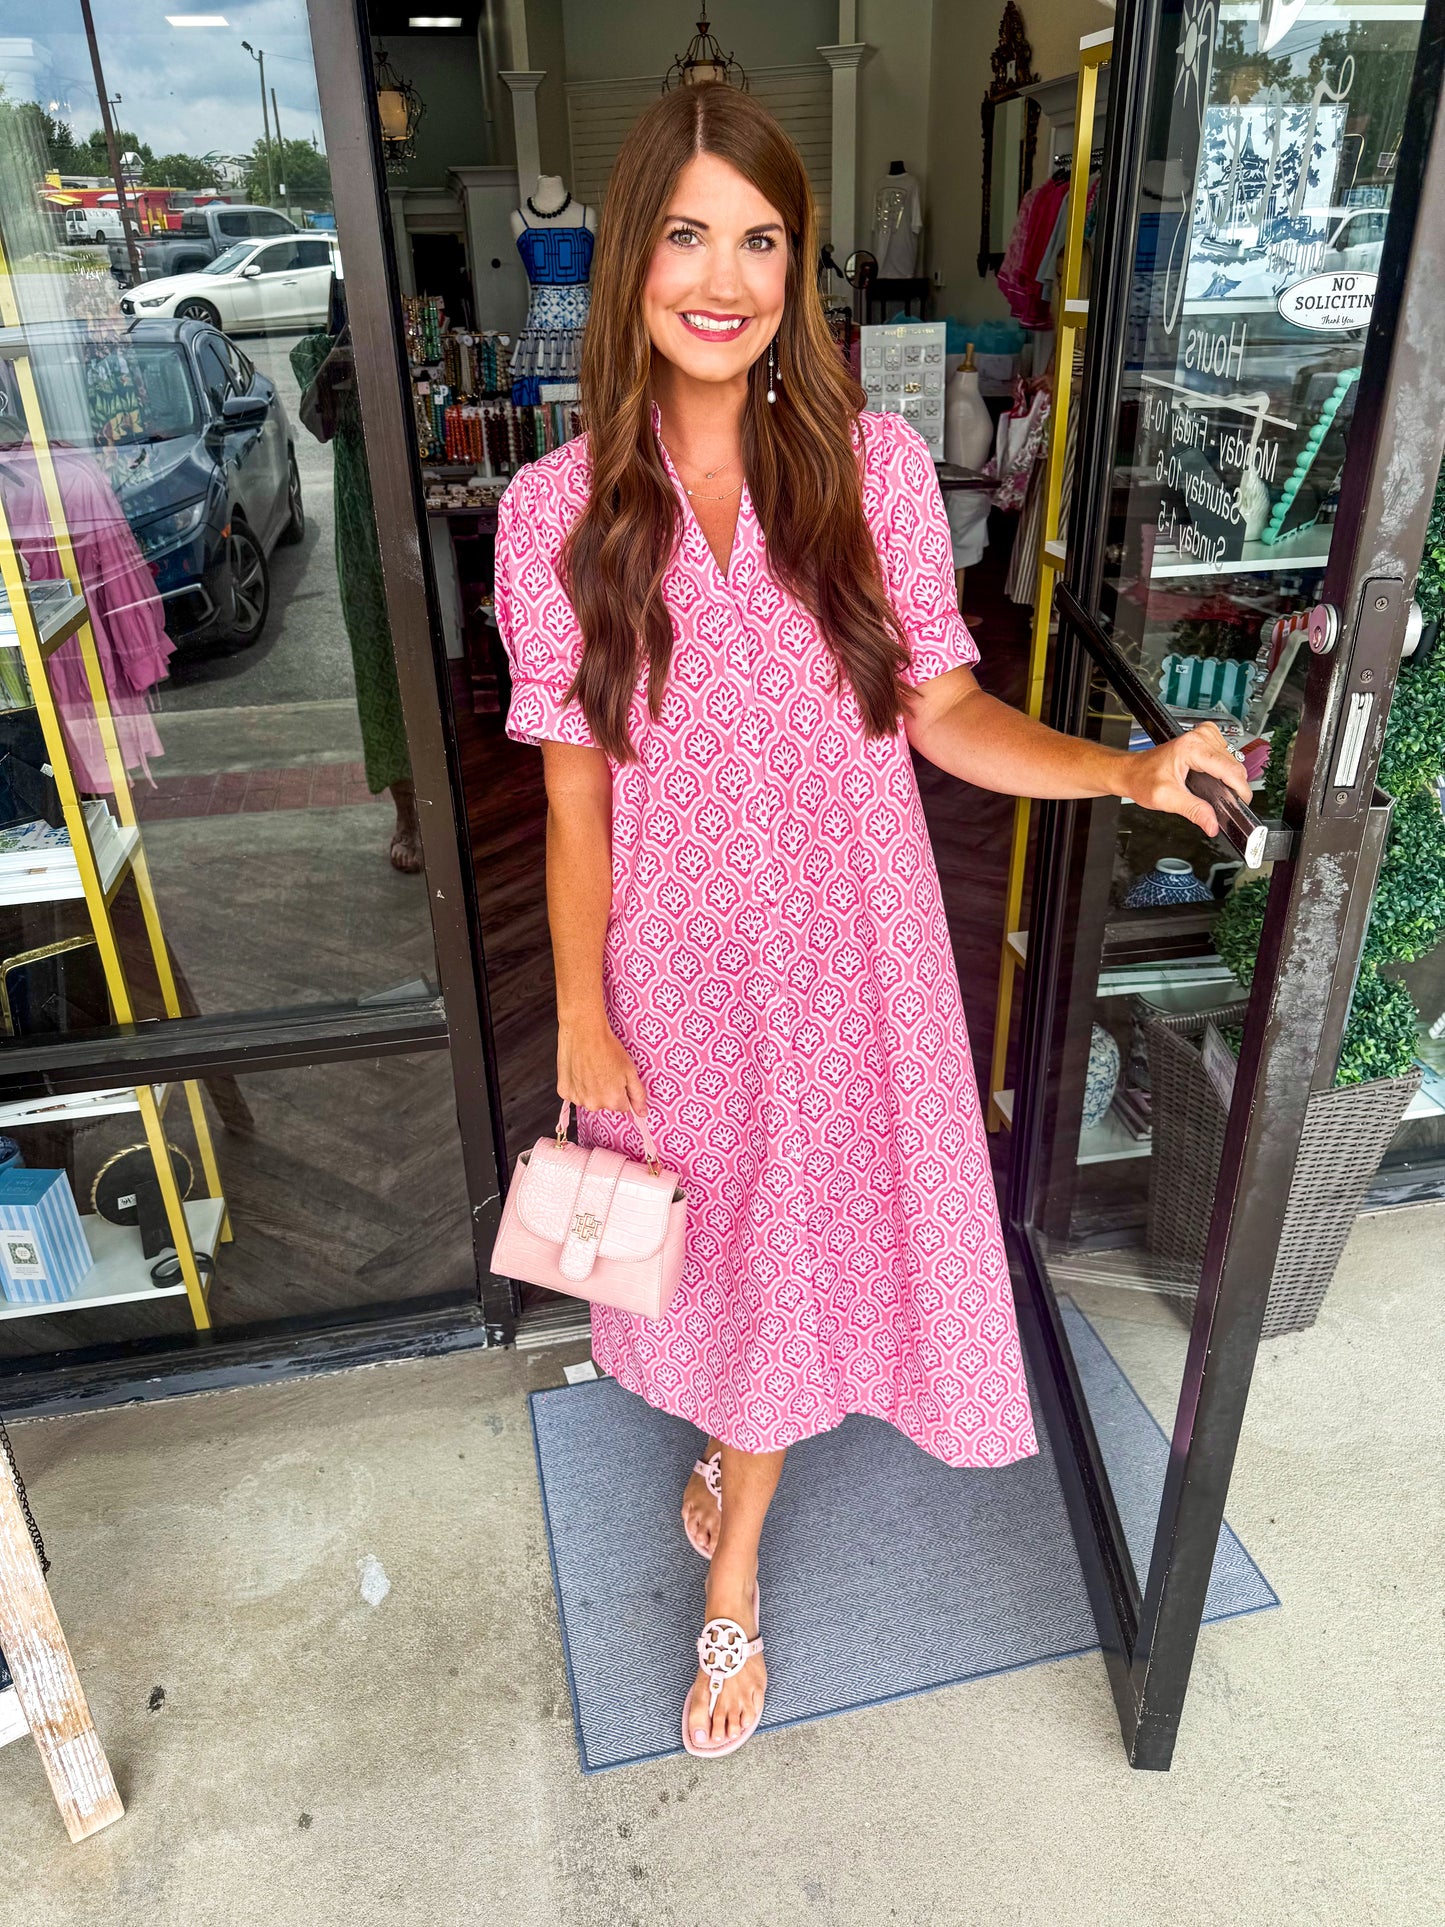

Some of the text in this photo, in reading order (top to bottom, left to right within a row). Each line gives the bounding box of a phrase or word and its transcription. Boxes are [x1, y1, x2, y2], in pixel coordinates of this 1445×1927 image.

[1332, 277, 1356, 291] NO
[1295, 294, 1375, 310] SOLICITIN
[1321, 314, 1355, 326] Thank You
